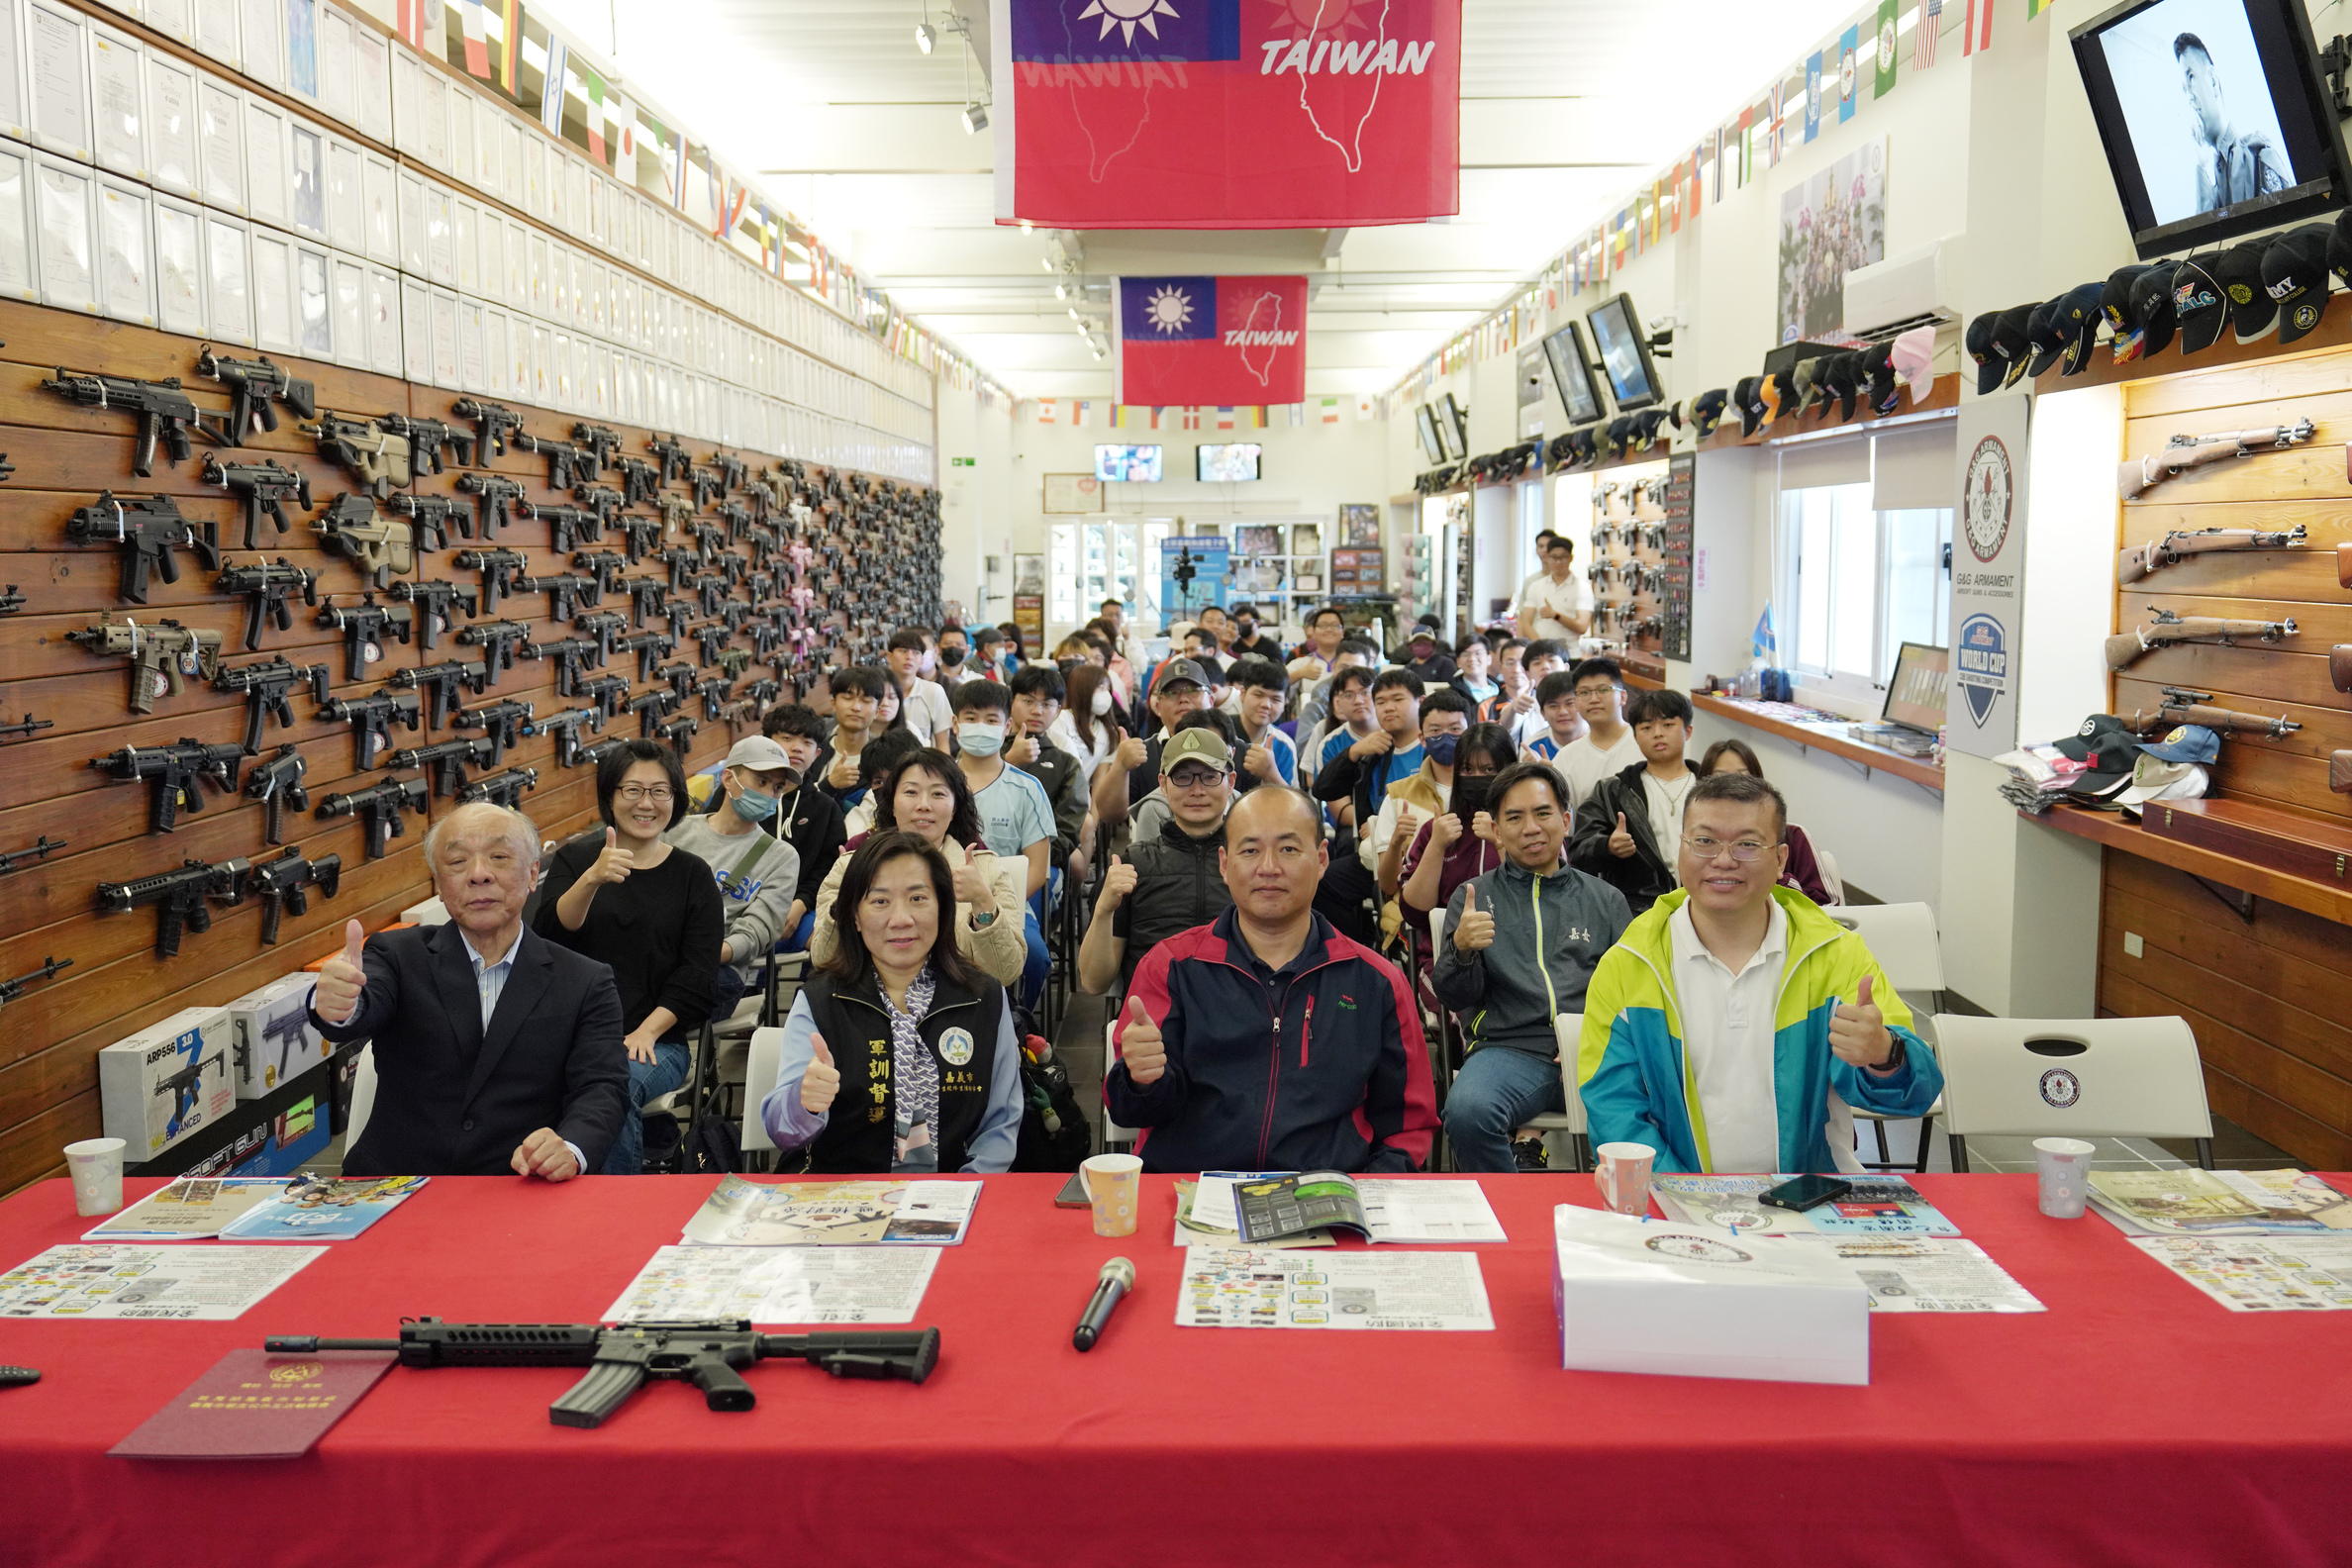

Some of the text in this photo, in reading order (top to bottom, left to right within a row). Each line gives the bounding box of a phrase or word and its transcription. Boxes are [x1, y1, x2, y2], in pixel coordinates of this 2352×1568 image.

[1260, 40, 1435, 75] TAIWAN
[1225, 330, 1299, 346] TAIWAN
[1980, 439, 2010, 476] ARMAMENT
[1975, 516, 2009, 559] ARMAMENT
[1956, 573, 2014, 588] G&G ARMAMENT
[1174, 663, 1189, 676] C
[1961, 648, 2006, 674] WORLD CUP
[181, 1032, 193, 1048] 3.0
[147, 1041, 176, 1066] ARP556
[867, 1039, 890, 1125] 軍訓督導
[945, 1071, 974, 1084] 嘉義市
[235, 1122, 267, 1155] GUN
[1365, 1320, 1445, 1328] 全民國防
